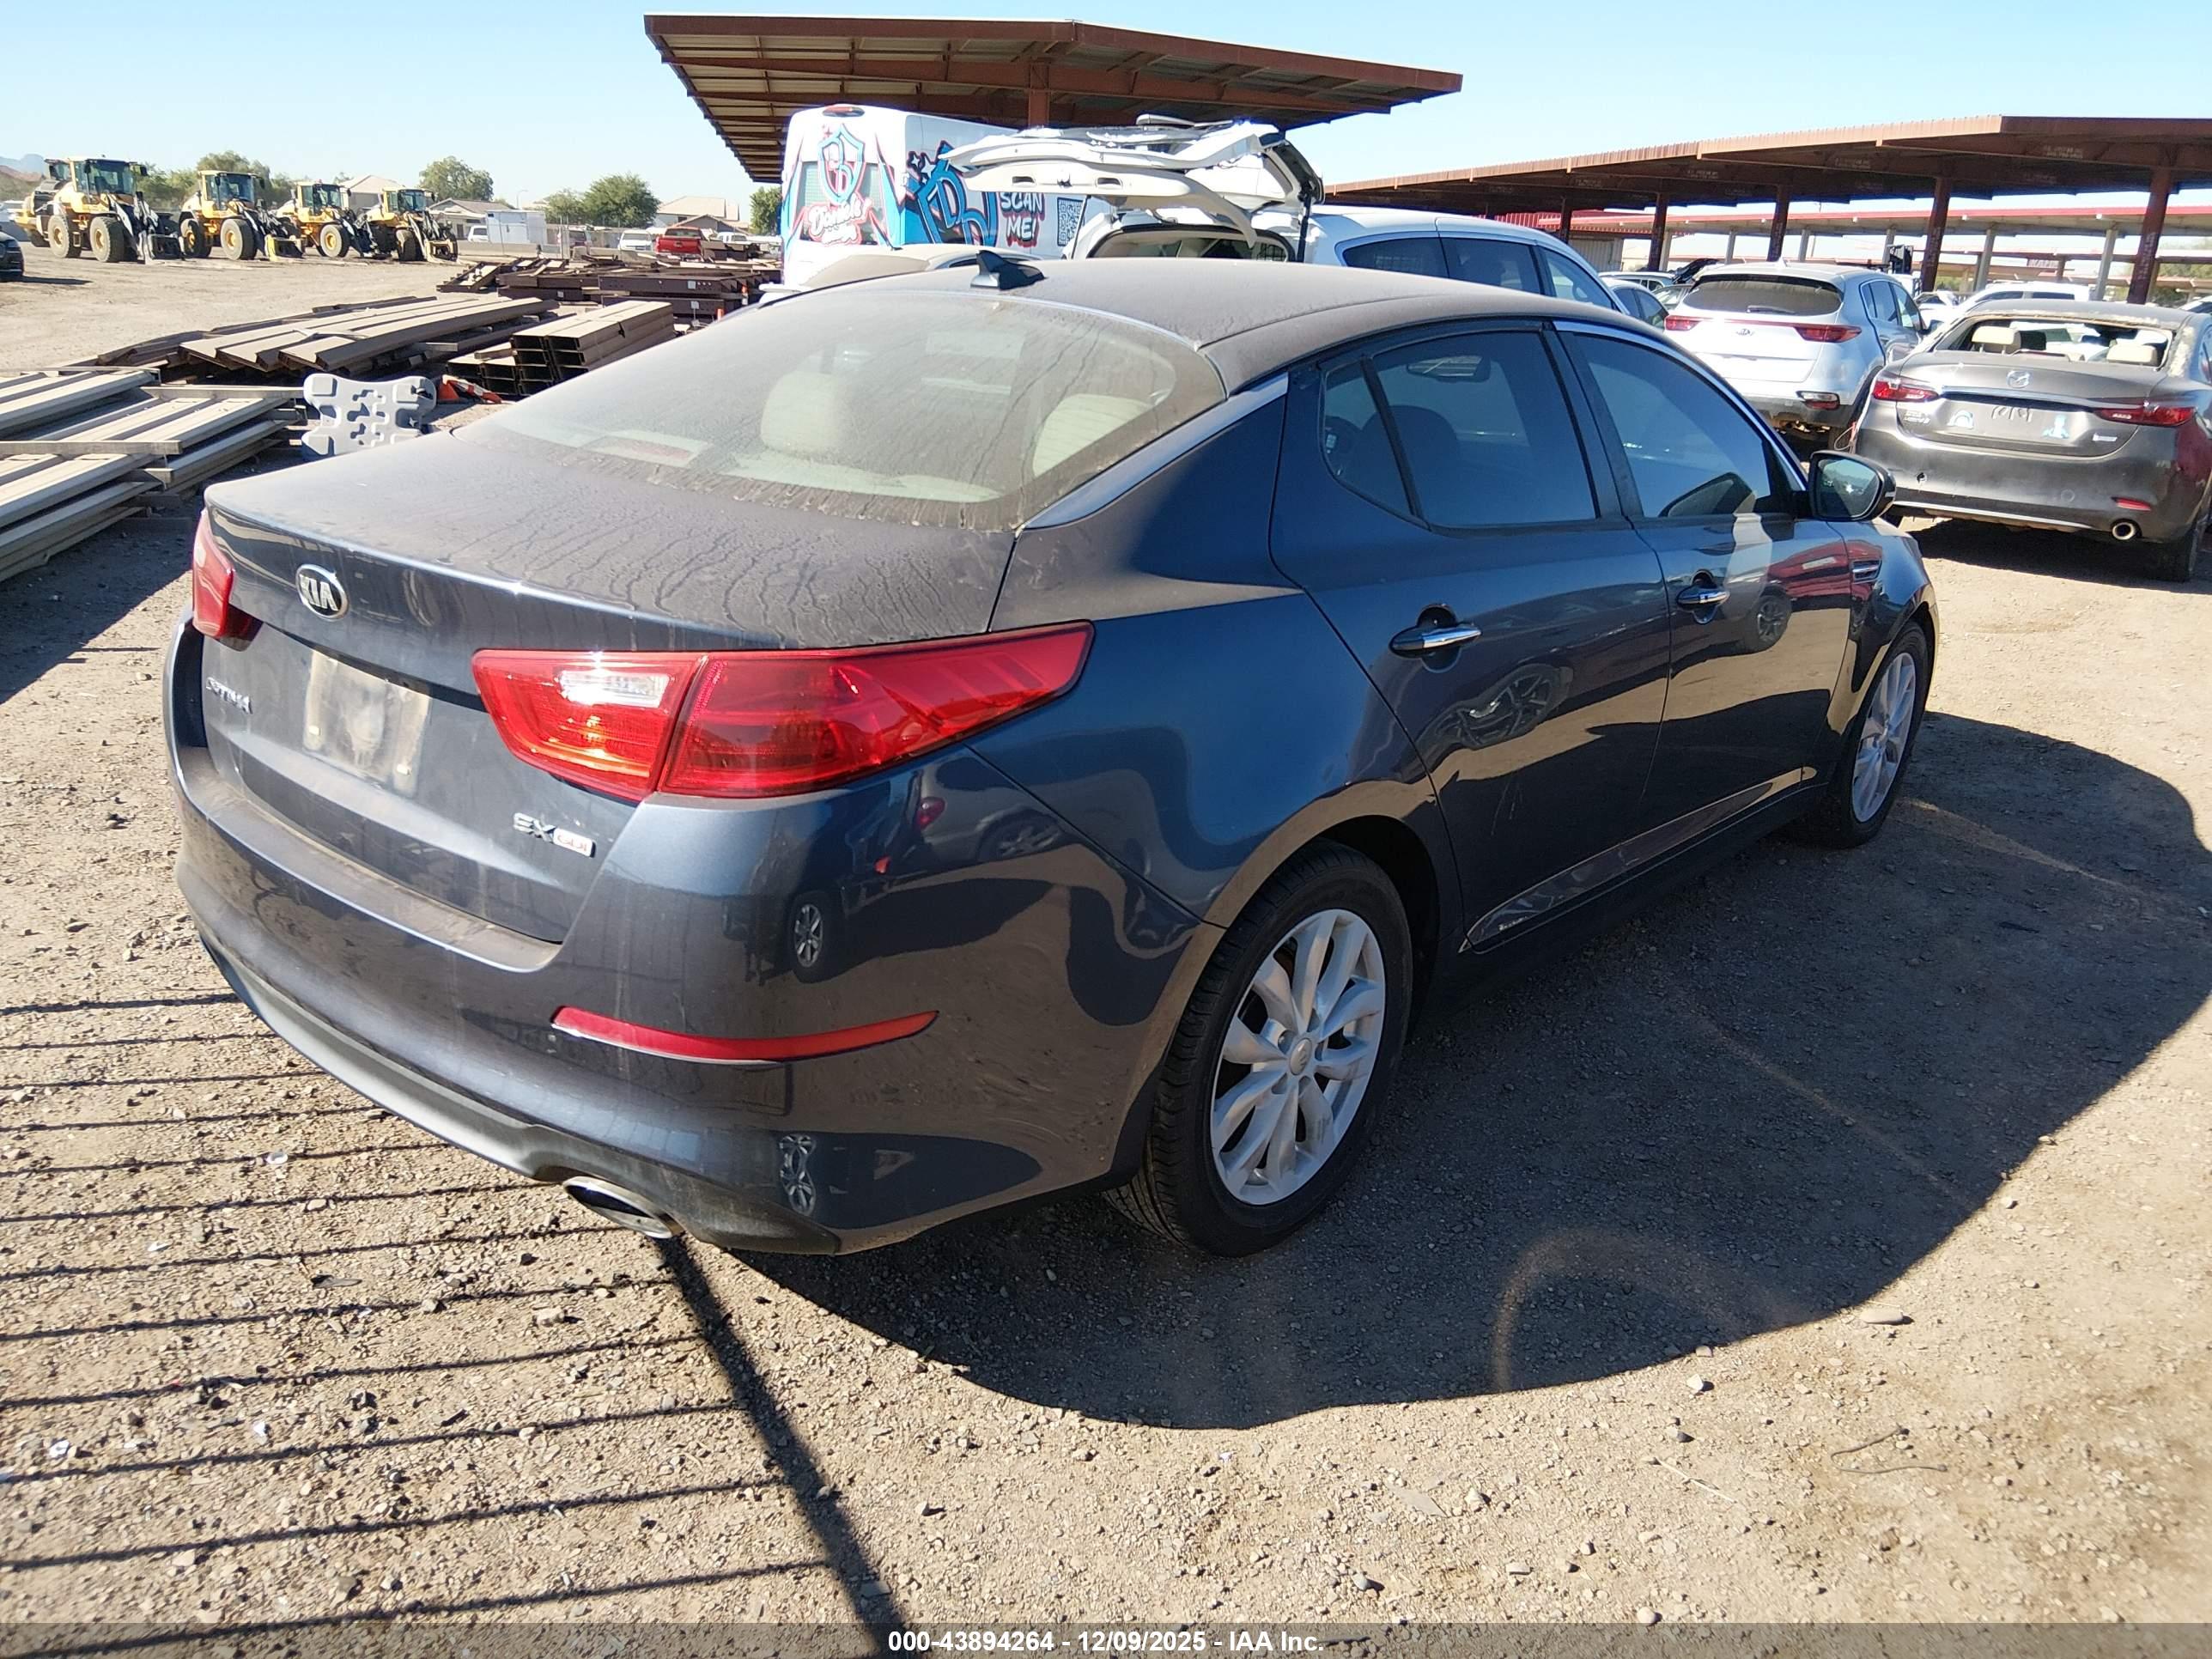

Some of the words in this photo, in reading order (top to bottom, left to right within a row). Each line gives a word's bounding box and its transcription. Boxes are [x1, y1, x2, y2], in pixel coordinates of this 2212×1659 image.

[1000, 191, 1043, 214] SCAN
[1006, 215, 1037, 240] ME!
[299, 573, 339, 611] KIA
